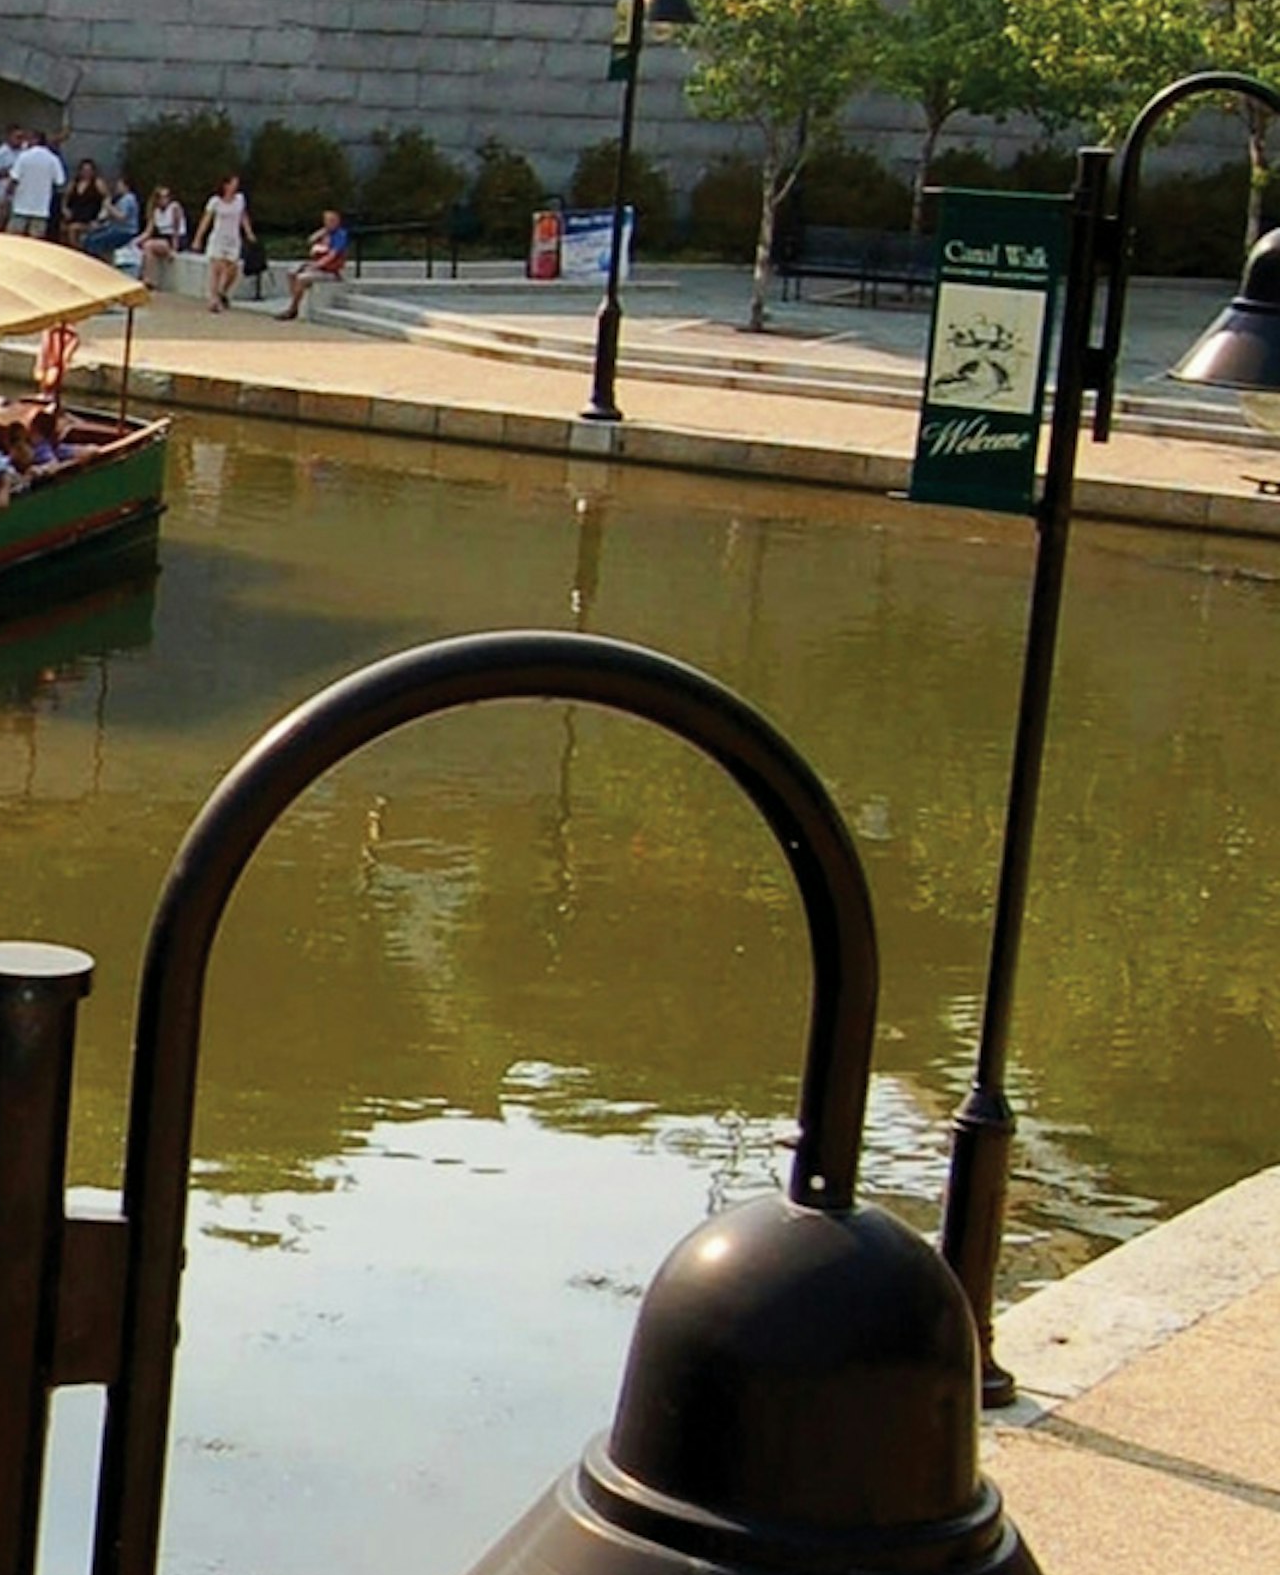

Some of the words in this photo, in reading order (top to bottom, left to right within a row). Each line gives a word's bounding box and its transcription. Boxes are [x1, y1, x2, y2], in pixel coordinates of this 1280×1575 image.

[944, 238, 1000, 266] Canal
[1004, 243, 1049, 269] Walk
[921, 414, 1031, 458] Welcome
